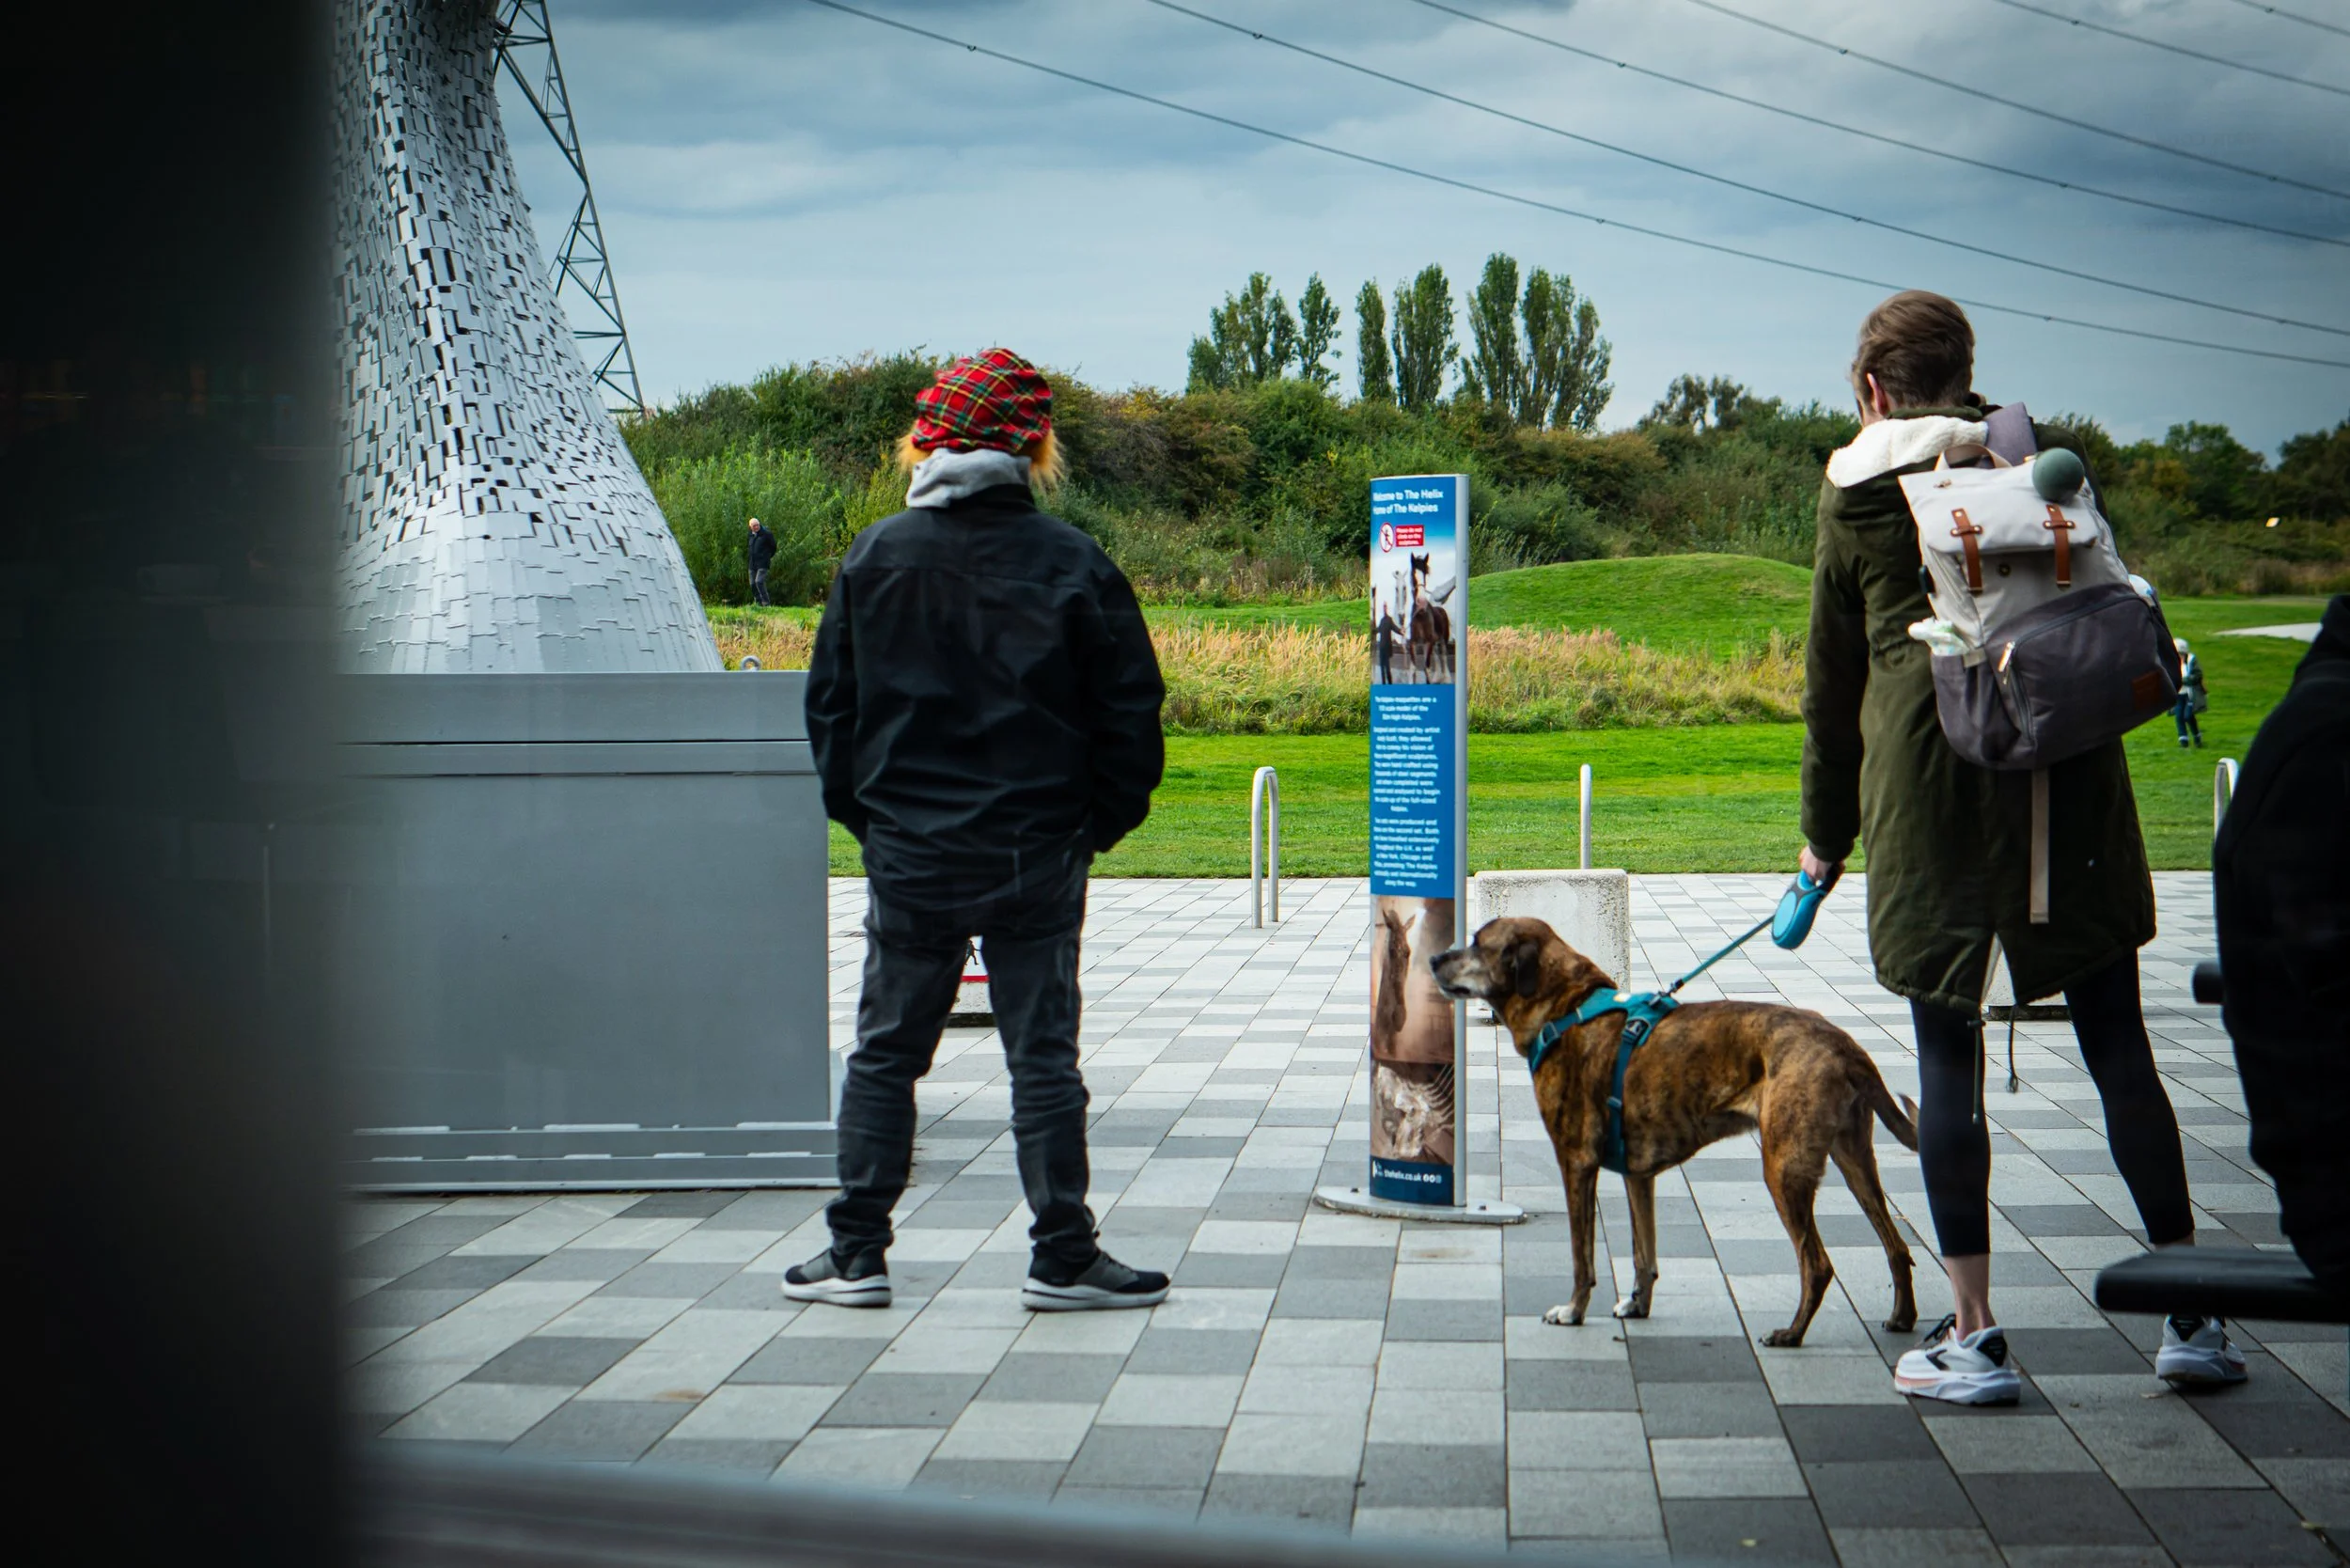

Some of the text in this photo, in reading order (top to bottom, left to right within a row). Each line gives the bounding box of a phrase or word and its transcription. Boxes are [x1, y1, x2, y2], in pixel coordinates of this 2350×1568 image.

[1404, 490, 1419, 499] The
[1420, 489, 1444, 498] Helix
[1386, 505, 1393, 513] of
[1393, 504, 1407, 512] The
[1408, 503, 1438, 514] Kelpies
